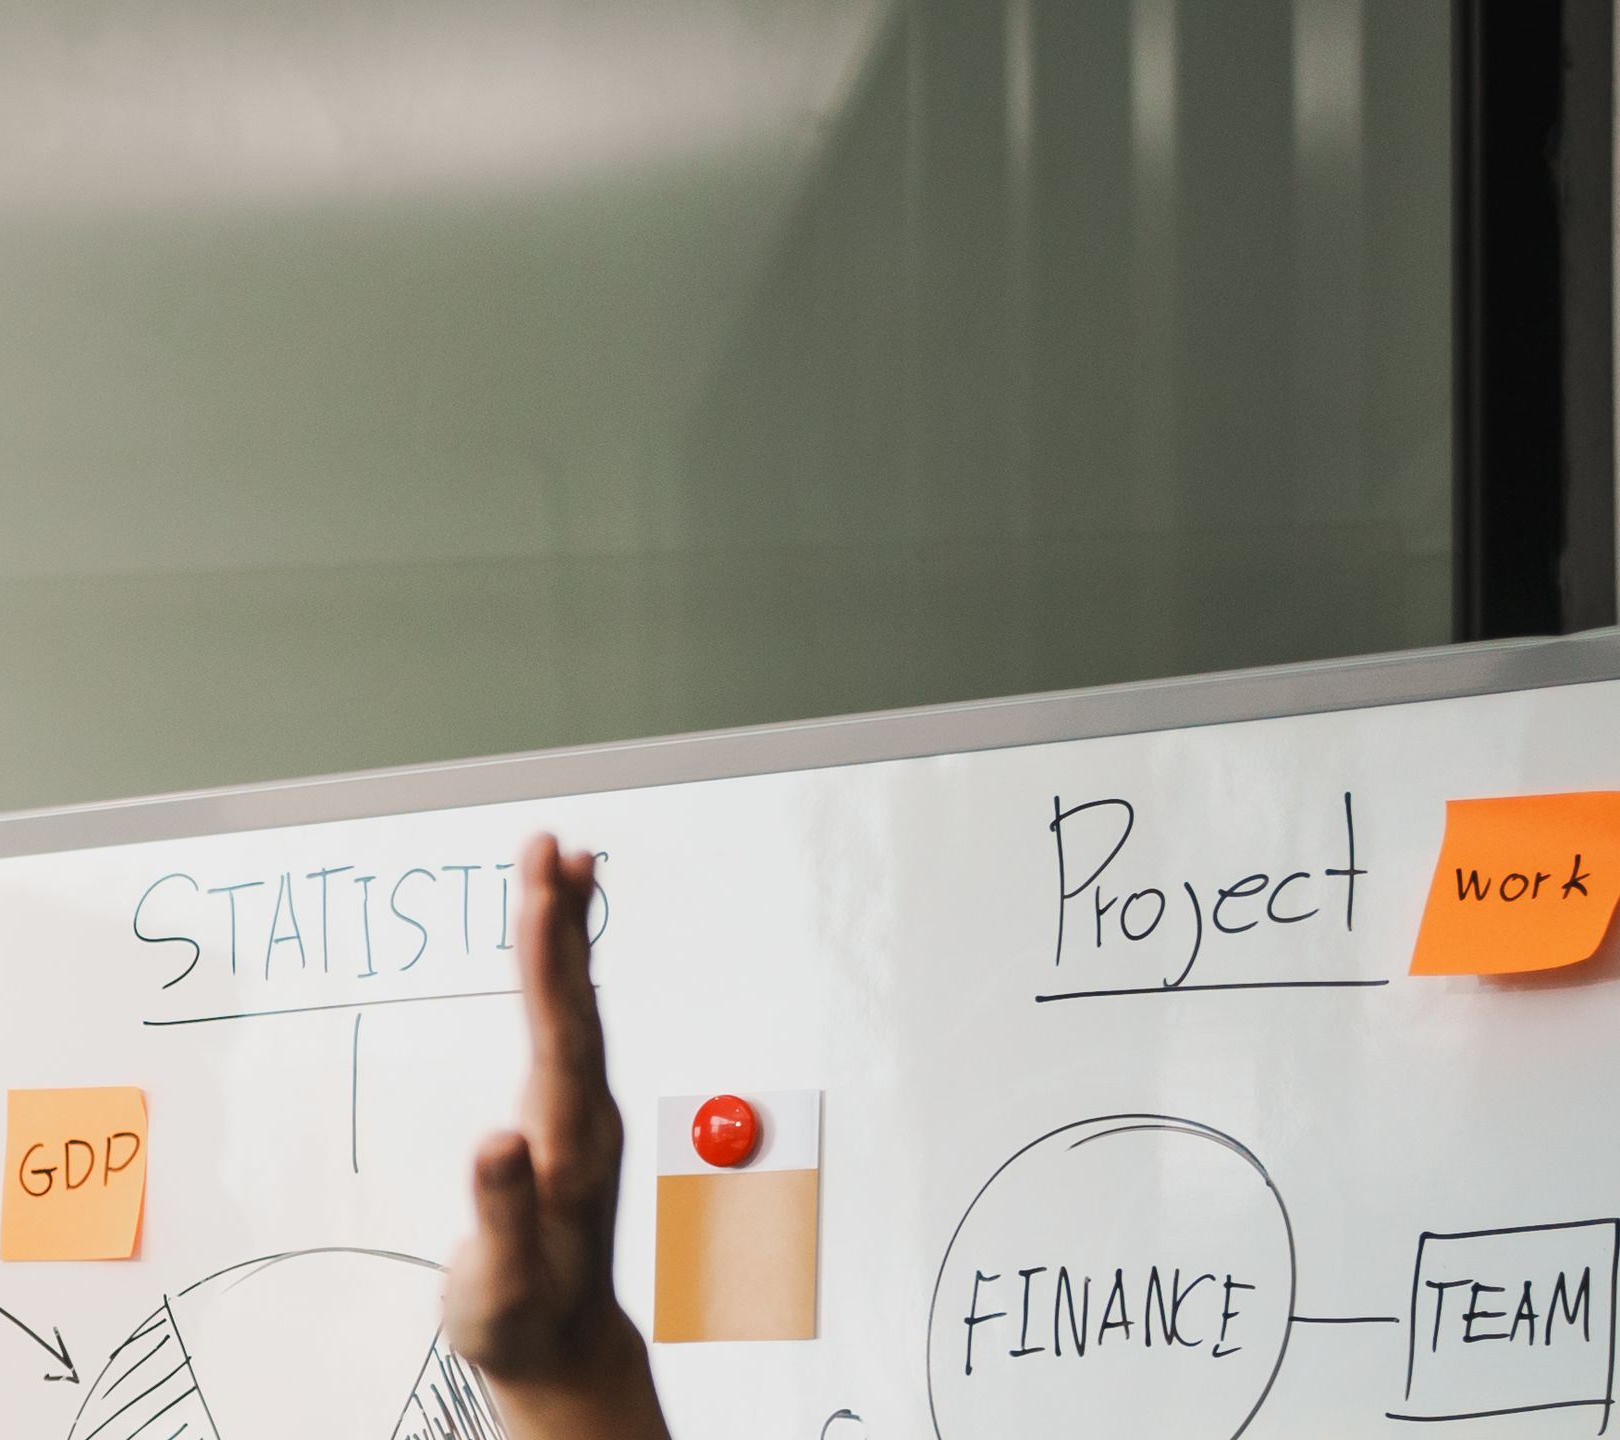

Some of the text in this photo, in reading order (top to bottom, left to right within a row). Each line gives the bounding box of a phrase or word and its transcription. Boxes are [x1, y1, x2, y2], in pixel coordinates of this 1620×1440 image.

[133, 852, 609, 990] STATISTI
[1049, 792, 1367, 989] Project
[1455, 854, 1591, 902] work
[19, 1132, 141, 1198] GDP
[964, 1265, 1256, 1376] FINANCE
[1425, 1265, 1592, 1353] TEAM
